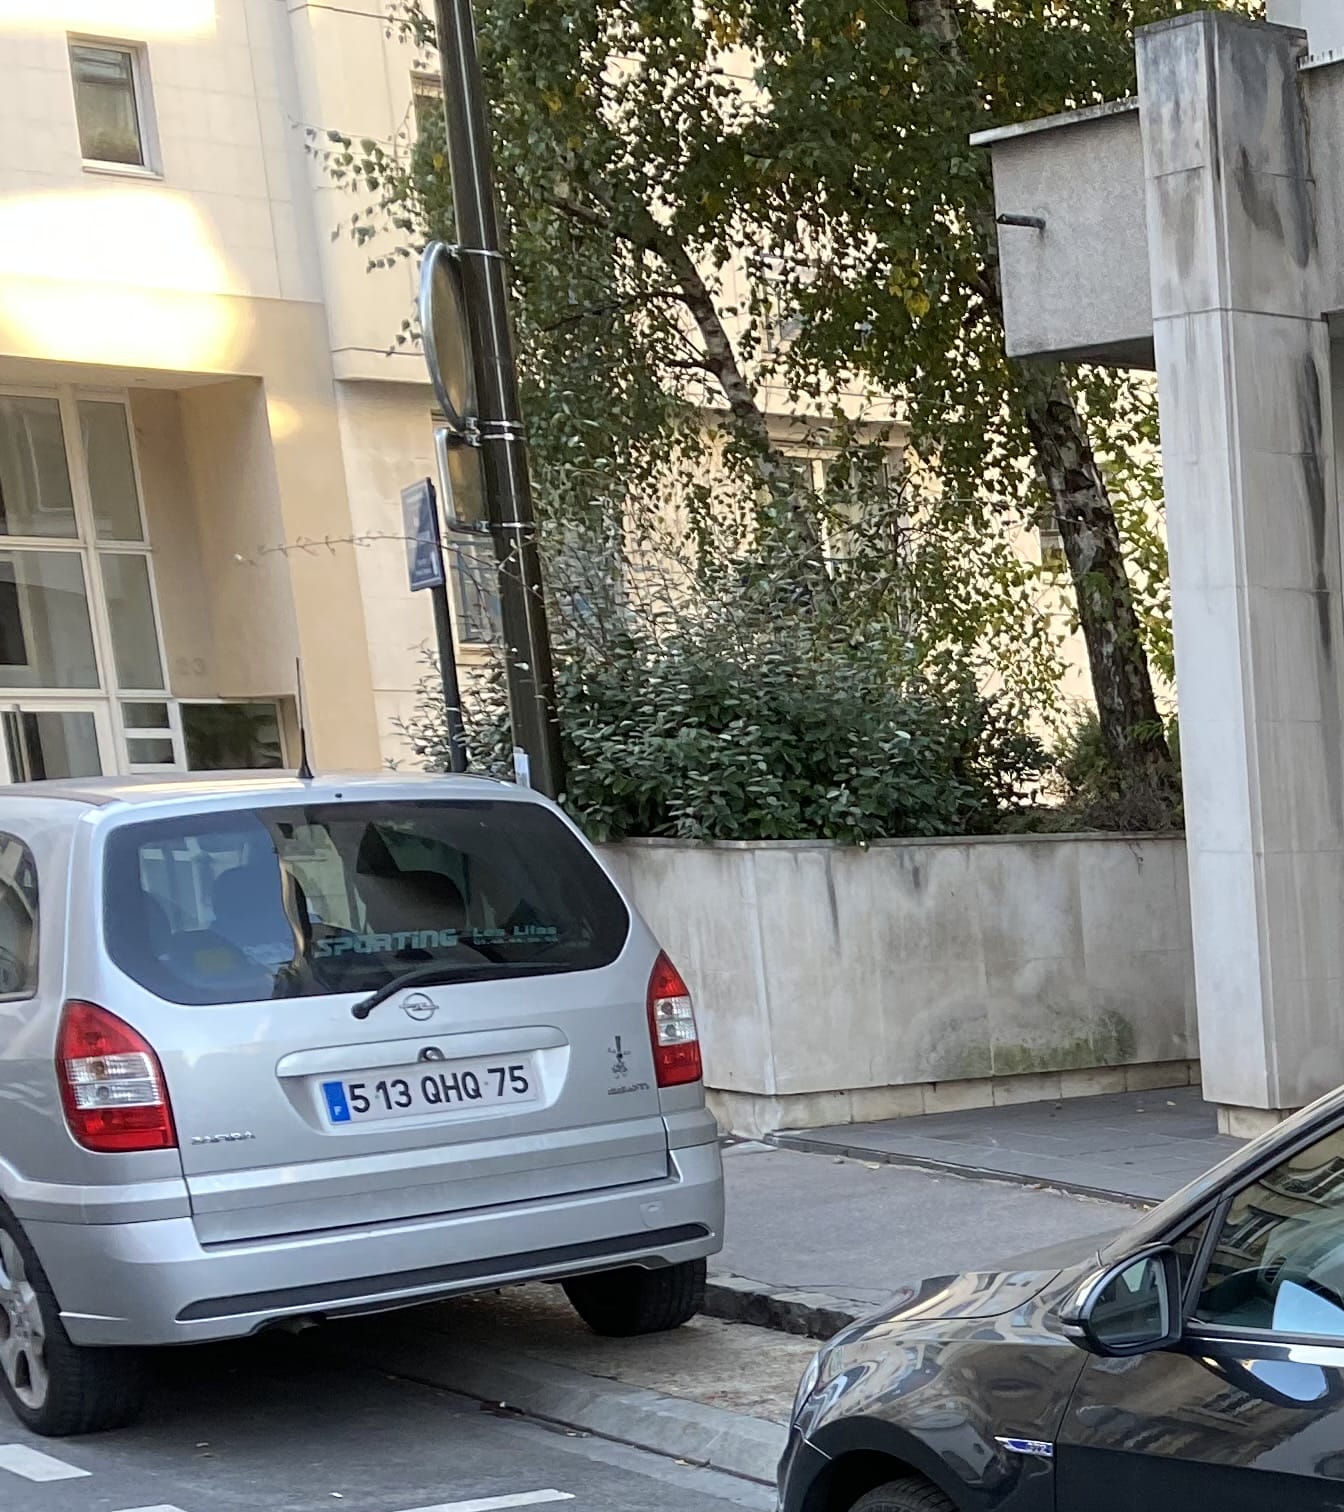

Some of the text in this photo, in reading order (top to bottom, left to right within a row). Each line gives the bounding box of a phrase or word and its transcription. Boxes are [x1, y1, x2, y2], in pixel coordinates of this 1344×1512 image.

[349, 1065, 529, 1113] 513 QHQ 75
